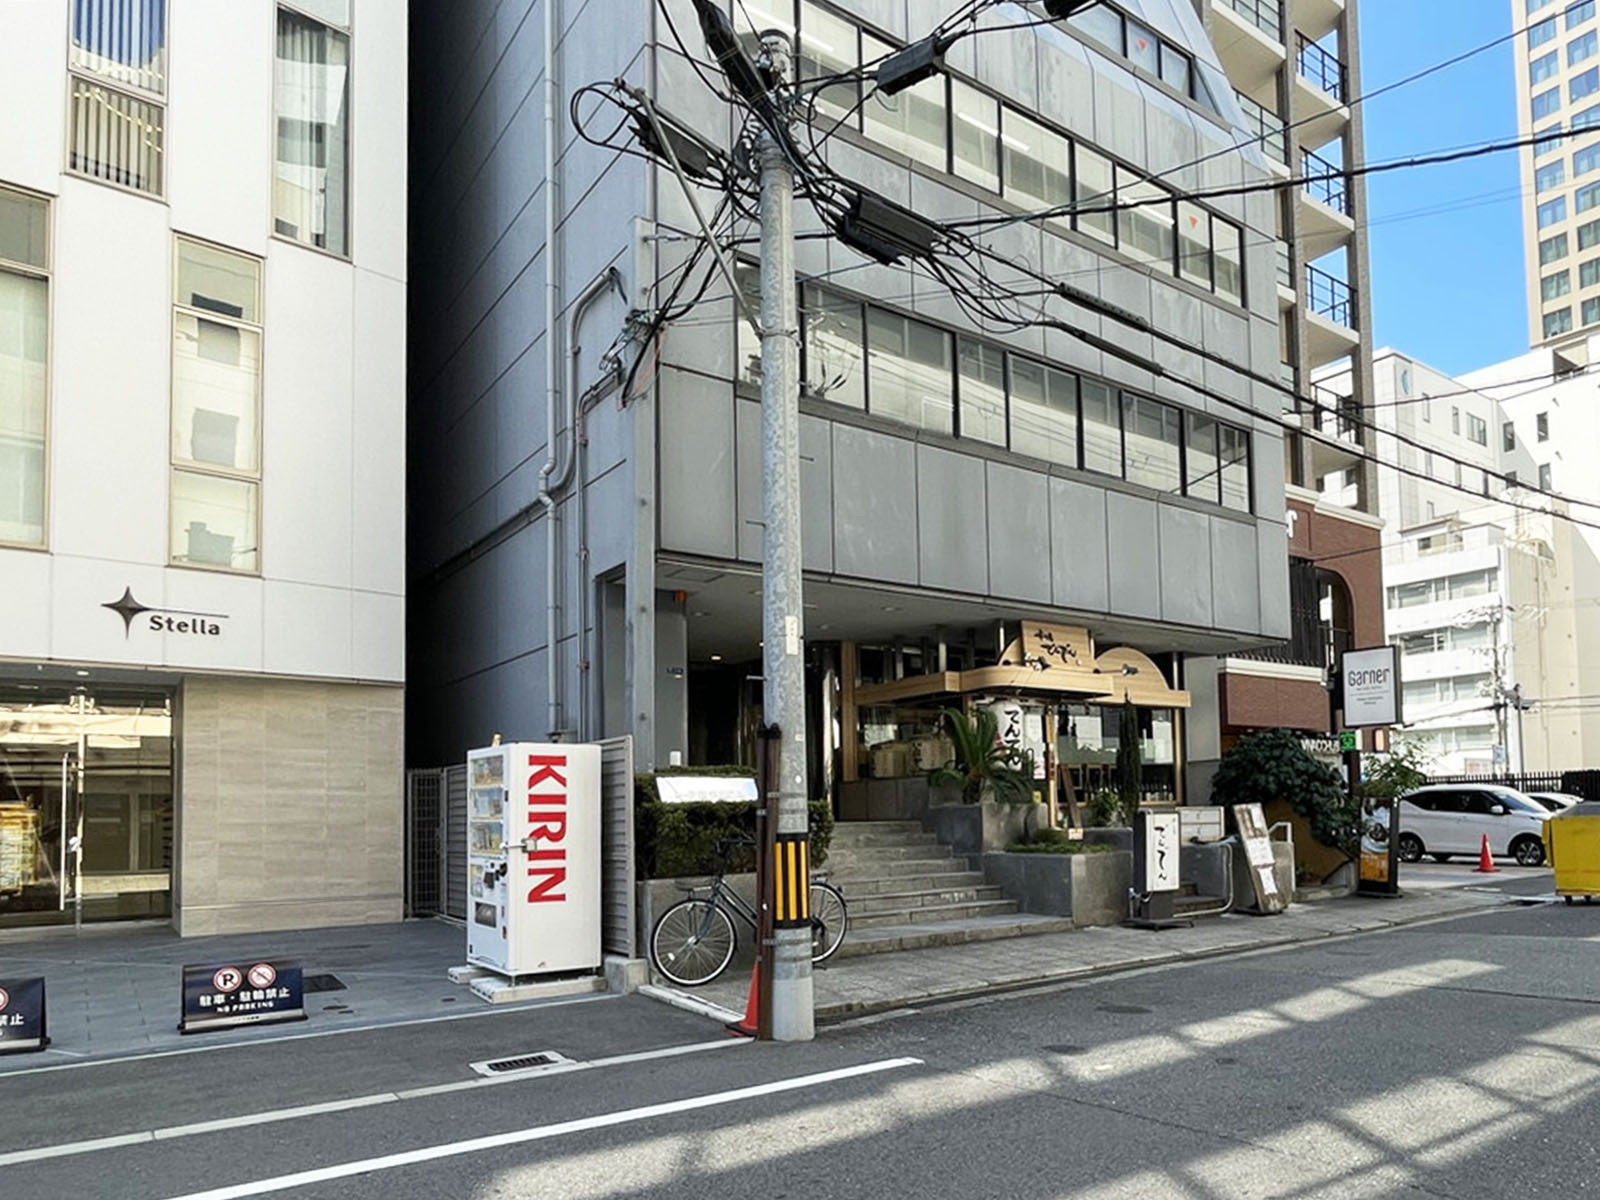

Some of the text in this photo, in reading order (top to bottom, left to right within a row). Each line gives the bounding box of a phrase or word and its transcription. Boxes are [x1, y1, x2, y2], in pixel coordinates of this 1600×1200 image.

[149, 614, 221, 636] Stella
[1348, 668, 1390, 687] Garner
[527, 754, 567, 904] KIRIN
[232, 1001, 275, 1012] PARKING
